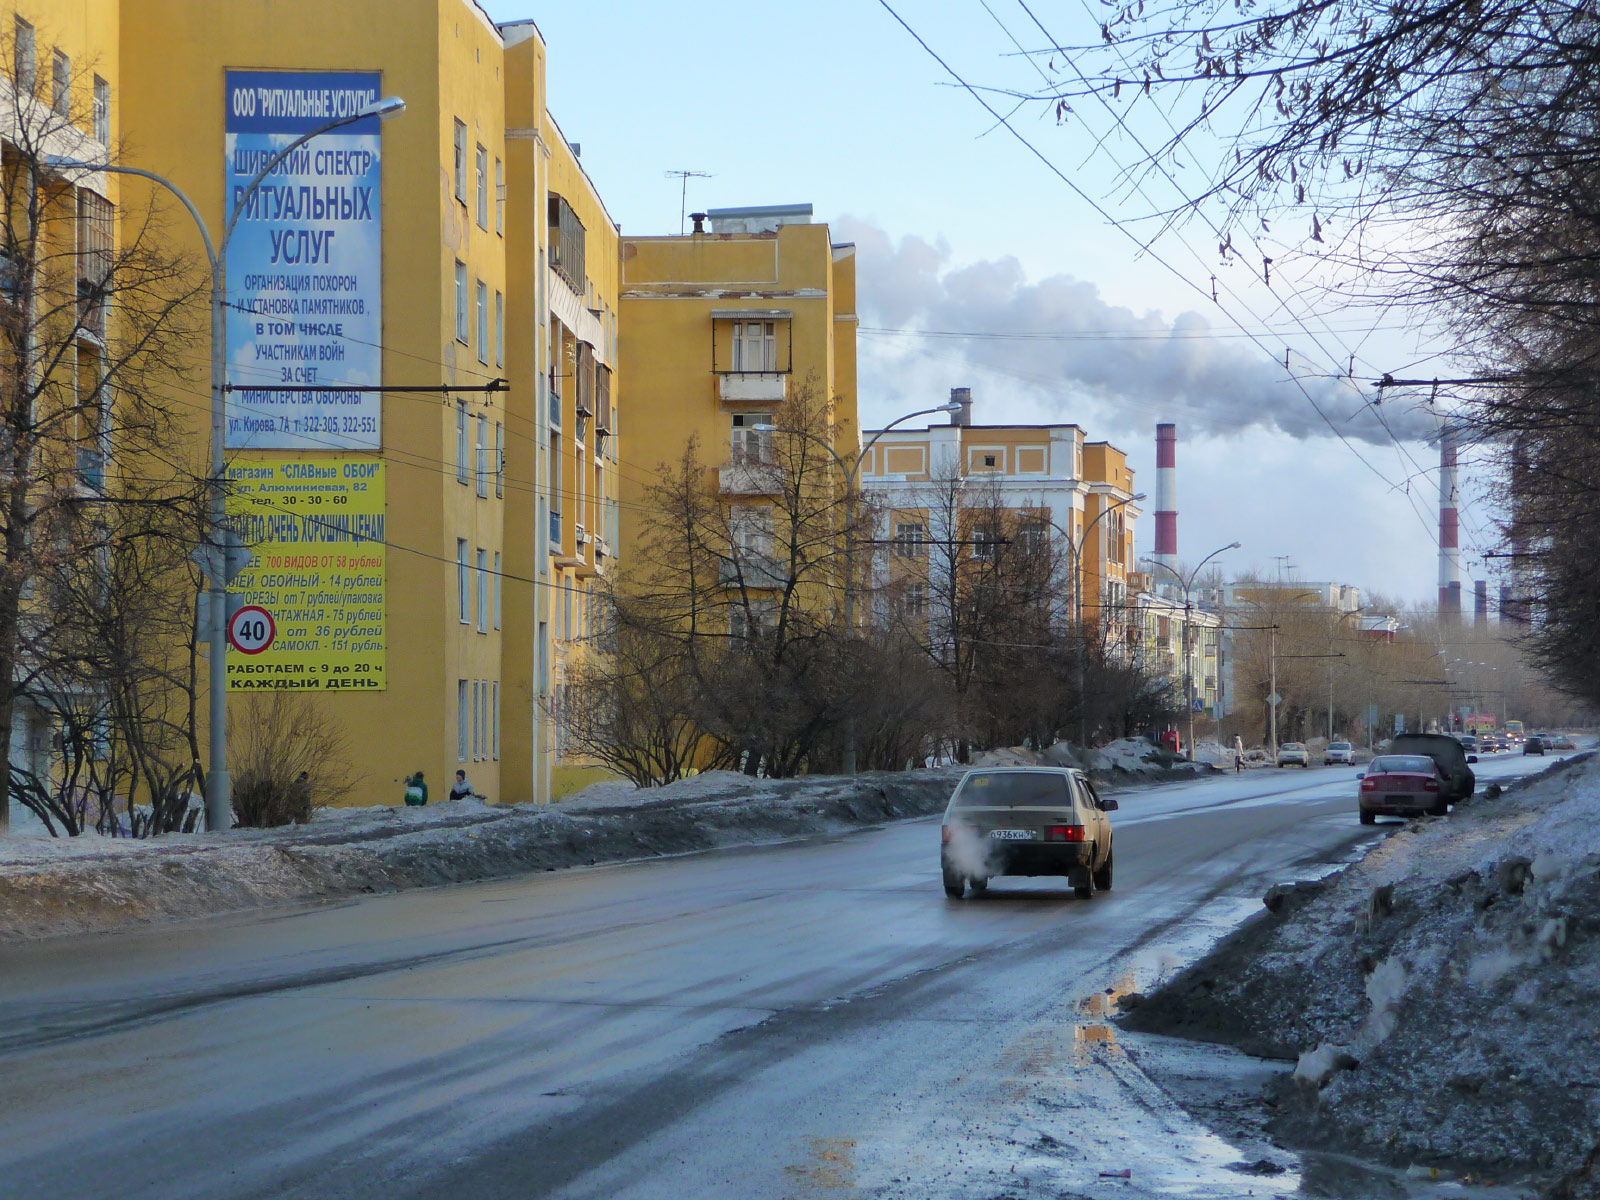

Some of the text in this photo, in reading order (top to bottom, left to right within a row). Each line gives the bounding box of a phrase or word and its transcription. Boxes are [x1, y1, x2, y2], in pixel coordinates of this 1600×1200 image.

[233, 88, 255, 117] ООО
[258, 88, 329, 117] "РИТУАЛЬНЫЕ
[234, 142, 371, 175] ШИРОКИЙ СПЕКТР
[233, 185, 372, 220] РИТУАЛЬНЫХ
[270, 230, 334, 264] УСЛУГ
[245, 274, 357, 293] ОРГАНИЗАЦИЯ ПОХОРОН
[237, 299, 245, 314] И
[247, 298, 299, 314] УСТАНОВКА
[255, 323, 343, 336] В ТОМ ЧИСЛЕ
[255, 340, 345, 361] УЧАСТНИКАМ ВОЙН
[281, 367, 318, 383] ЗА СЧЕТ
[241, 389, 361, 405] МИНИСТЕРСТВА ОБОРОНЫ
[229, 419, 242, 436] ул.
[244, 416, 276, 435] Кирова,
[279, 416, 290, 432] 7А
[304, 416, 340, 435] 322-305,
[342, 417, 376, 432] 322-551
[228, 466, 274, 479] магазин
[259, 483, 349, 493] Алюминиевая,
[353, 482, 367, 491] 82
[250, 497, 275, 506] тел.
[282, 496, 297, 505] 30
[307, 496, 322, 505] 30
[332, 496, 347, 505] 60
[251, 514, 265, 543] ПО
[268, 514, 299, 542] ОЧЕНЬ
[301, 514, 349, 542] ХОРОШИМ
[351, 514, 384, 544] ЦЕНАМ
[266, 556, 281, 568] 700
[284, 556, 318, 570] ВИДОВ
[320, 556, 335, 568] ОТ
[337, 556, 347, 568] 58
[349, 555, 382, 570] рублей
[260, 572, 319, 587] ОБОЙНЫЙ
[329, 575, 341, 587] 14
[344, 573, 382, 589] рублей
[284, 594, 297, 604] от
[300, 591, 306, 603] 7
[307, 590, 382, 607] рублей/упаковка
[333, 609, 344, 620] 75
[346, 608, 382, 623] рублей
[240, 620, 265, 641] 40
[287, 628, 307, 636] от
[315, 625, 330, 636] 36
[334, 625, 382, 639] рублей
[272, 640, 320, 651] САМОКЛ.
[331, 640, 348, 650] 151
[351, 640, 383, 653] рубль
[227, 665, 304, 673] РАБОТАЕМ
[321, 664, 329, 673] 9
[333, 666, 349, 674] до
[354, 664, 370, 672] 20
[231, 677, 378, 689] КАЖДЫЙ ДЕНЬ
